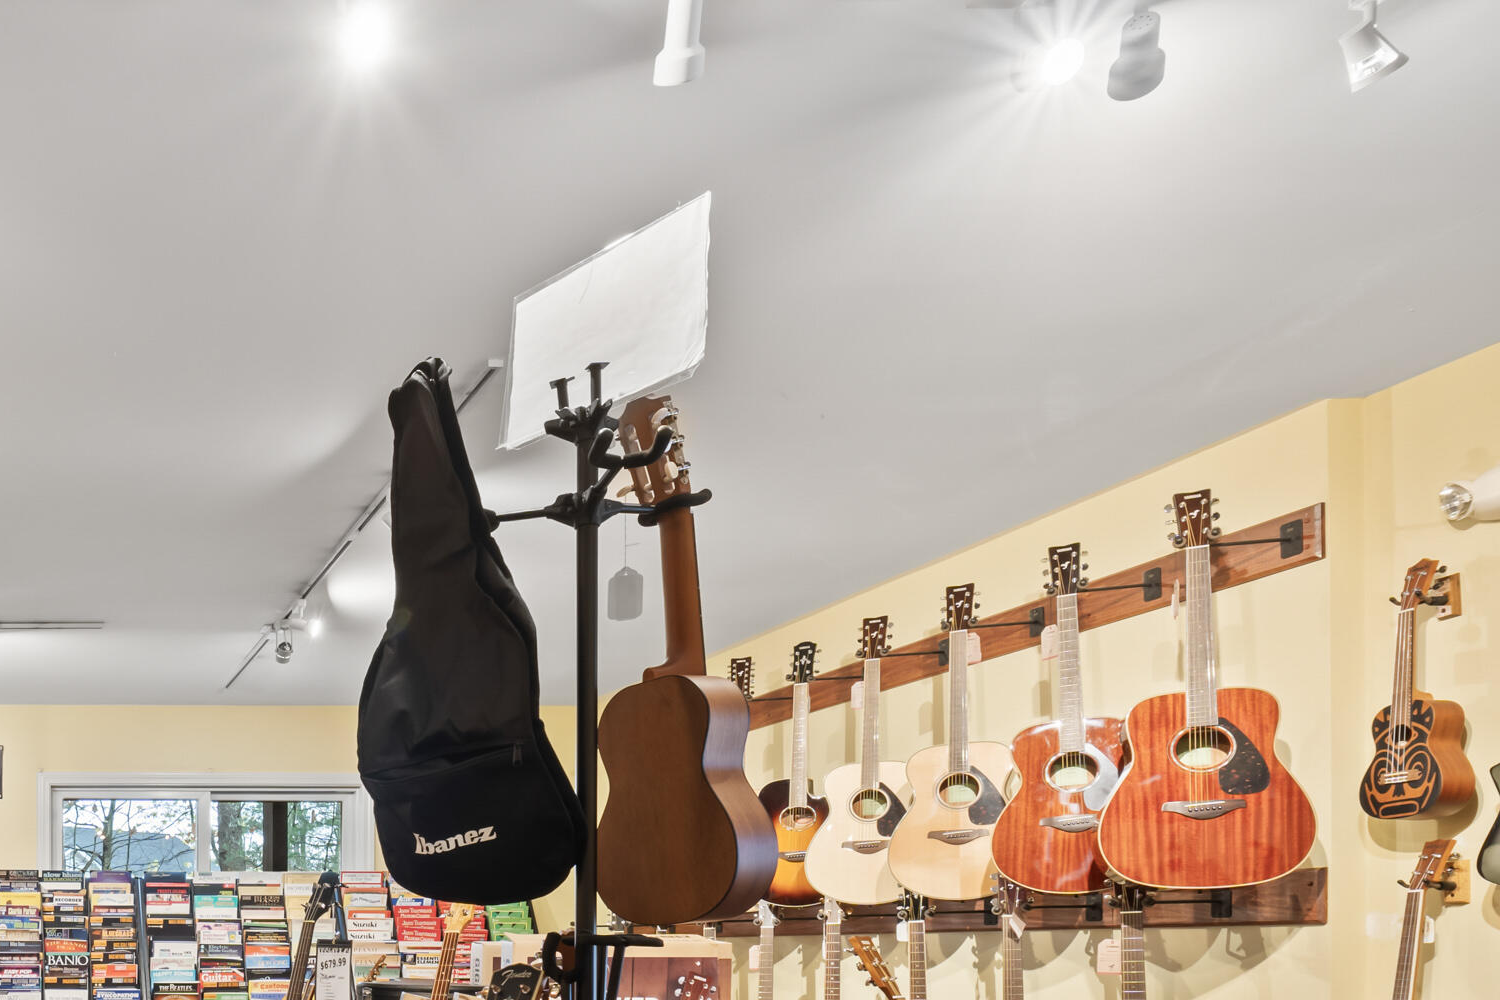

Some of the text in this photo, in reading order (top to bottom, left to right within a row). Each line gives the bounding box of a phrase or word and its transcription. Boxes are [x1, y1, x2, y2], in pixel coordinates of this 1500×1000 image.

[413, 826, 497, 855] Ibanez
[320, 957, 347, 970] $679.99
[202, 974, 232, 982] Guitar
